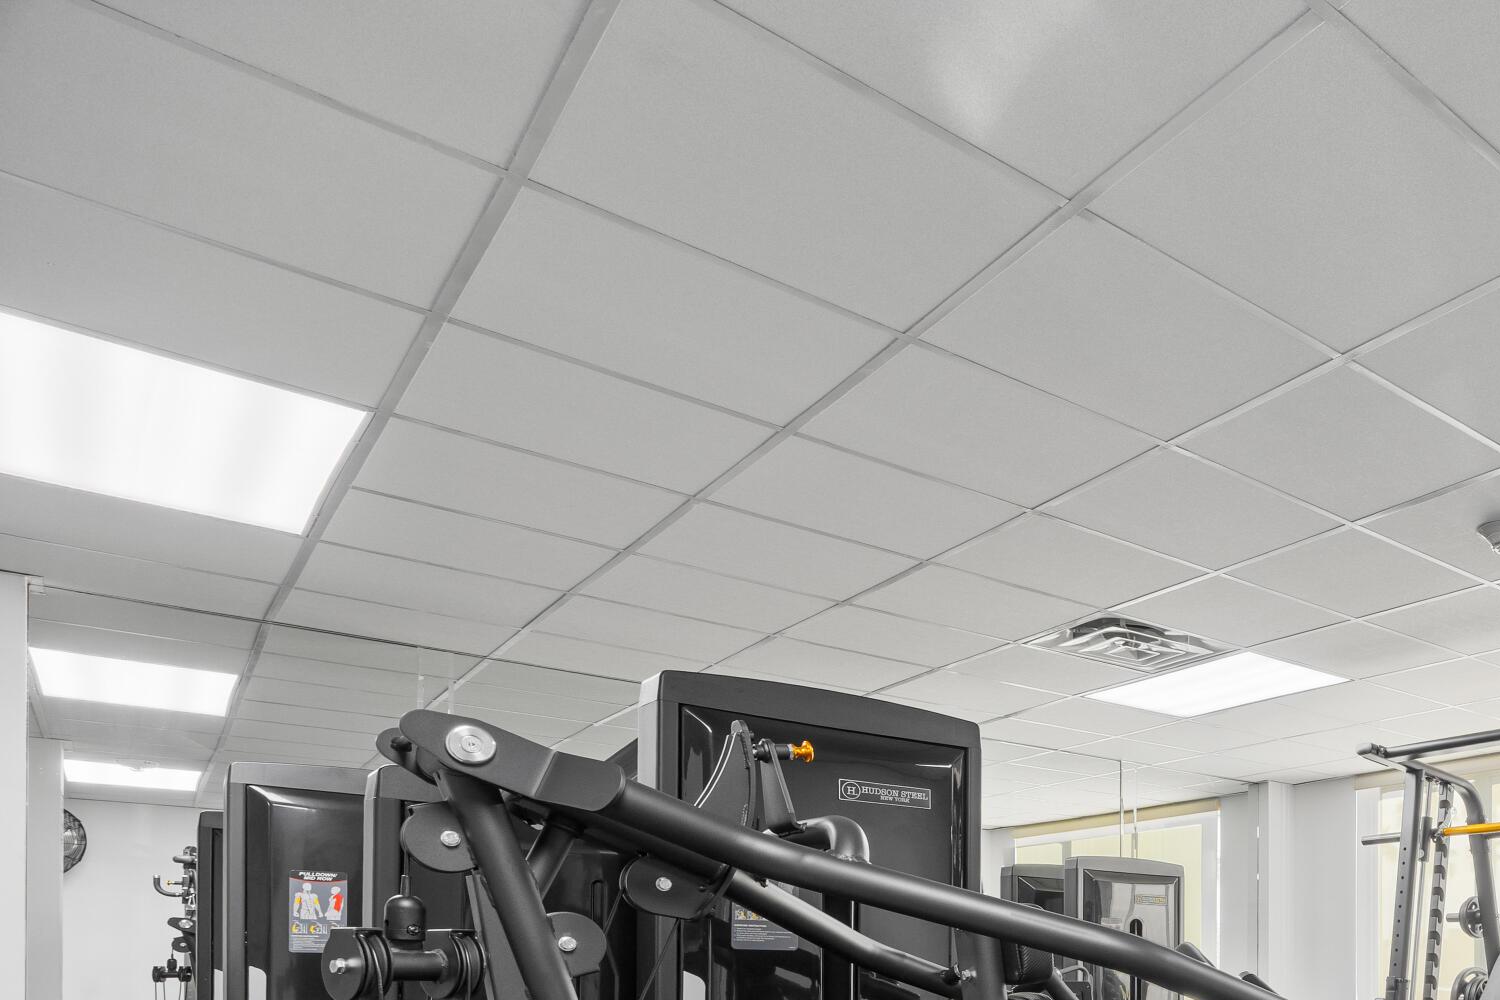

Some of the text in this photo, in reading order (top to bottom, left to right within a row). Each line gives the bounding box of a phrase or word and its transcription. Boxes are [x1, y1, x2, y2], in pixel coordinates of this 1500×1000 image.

[862, 786, 929, 801] HUDSON STEEL
[895, 796, 910, 804] YORK
